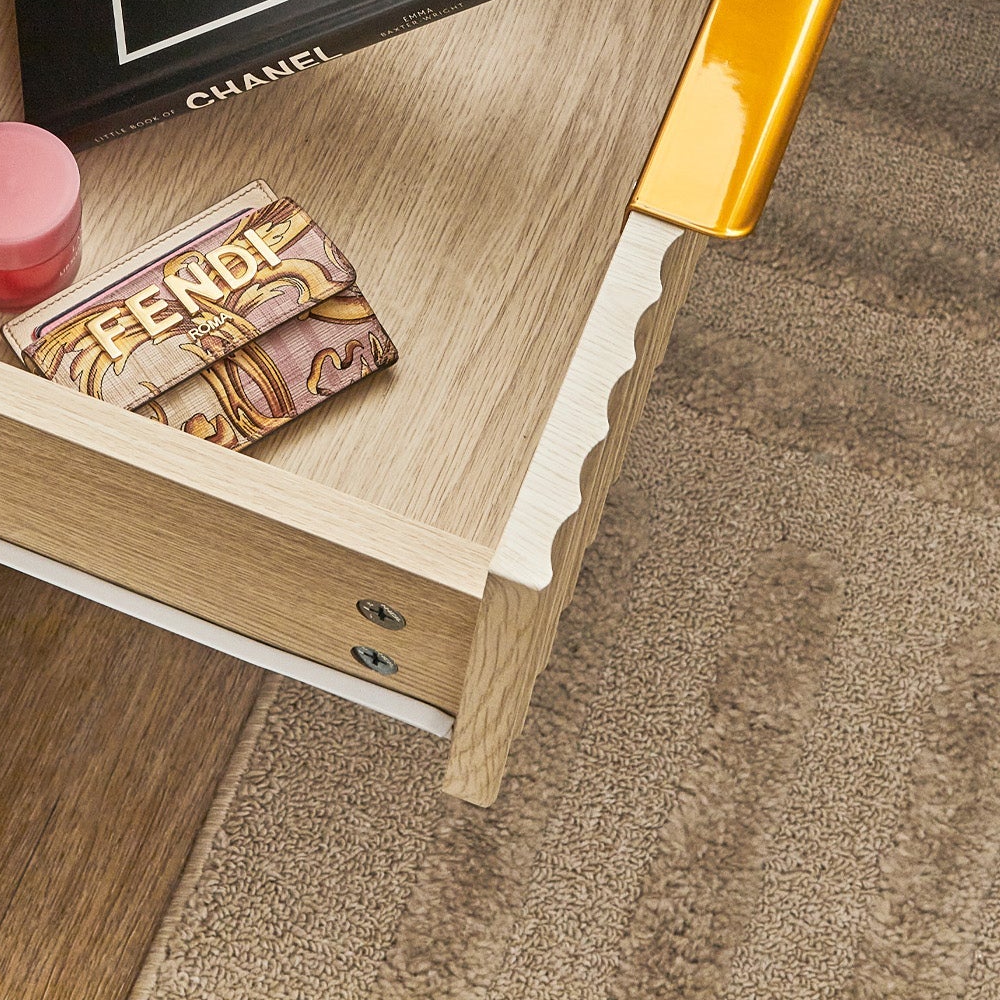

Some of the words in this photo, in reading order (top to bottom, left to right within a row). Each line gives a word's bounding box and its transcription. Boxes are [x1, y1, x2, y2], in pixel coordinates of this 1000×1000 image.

[402, 7, 434, 22] EMMA
[94, 127, 127, 143] LITTLE
[129, 116, 160, 130] BOOK
[162, 109, 175, 118] OF
[186, 47, 343, 110] CHANEL
[85, 229, 281, 361] FENDI
[188, 312, 234, 341] ROMA
